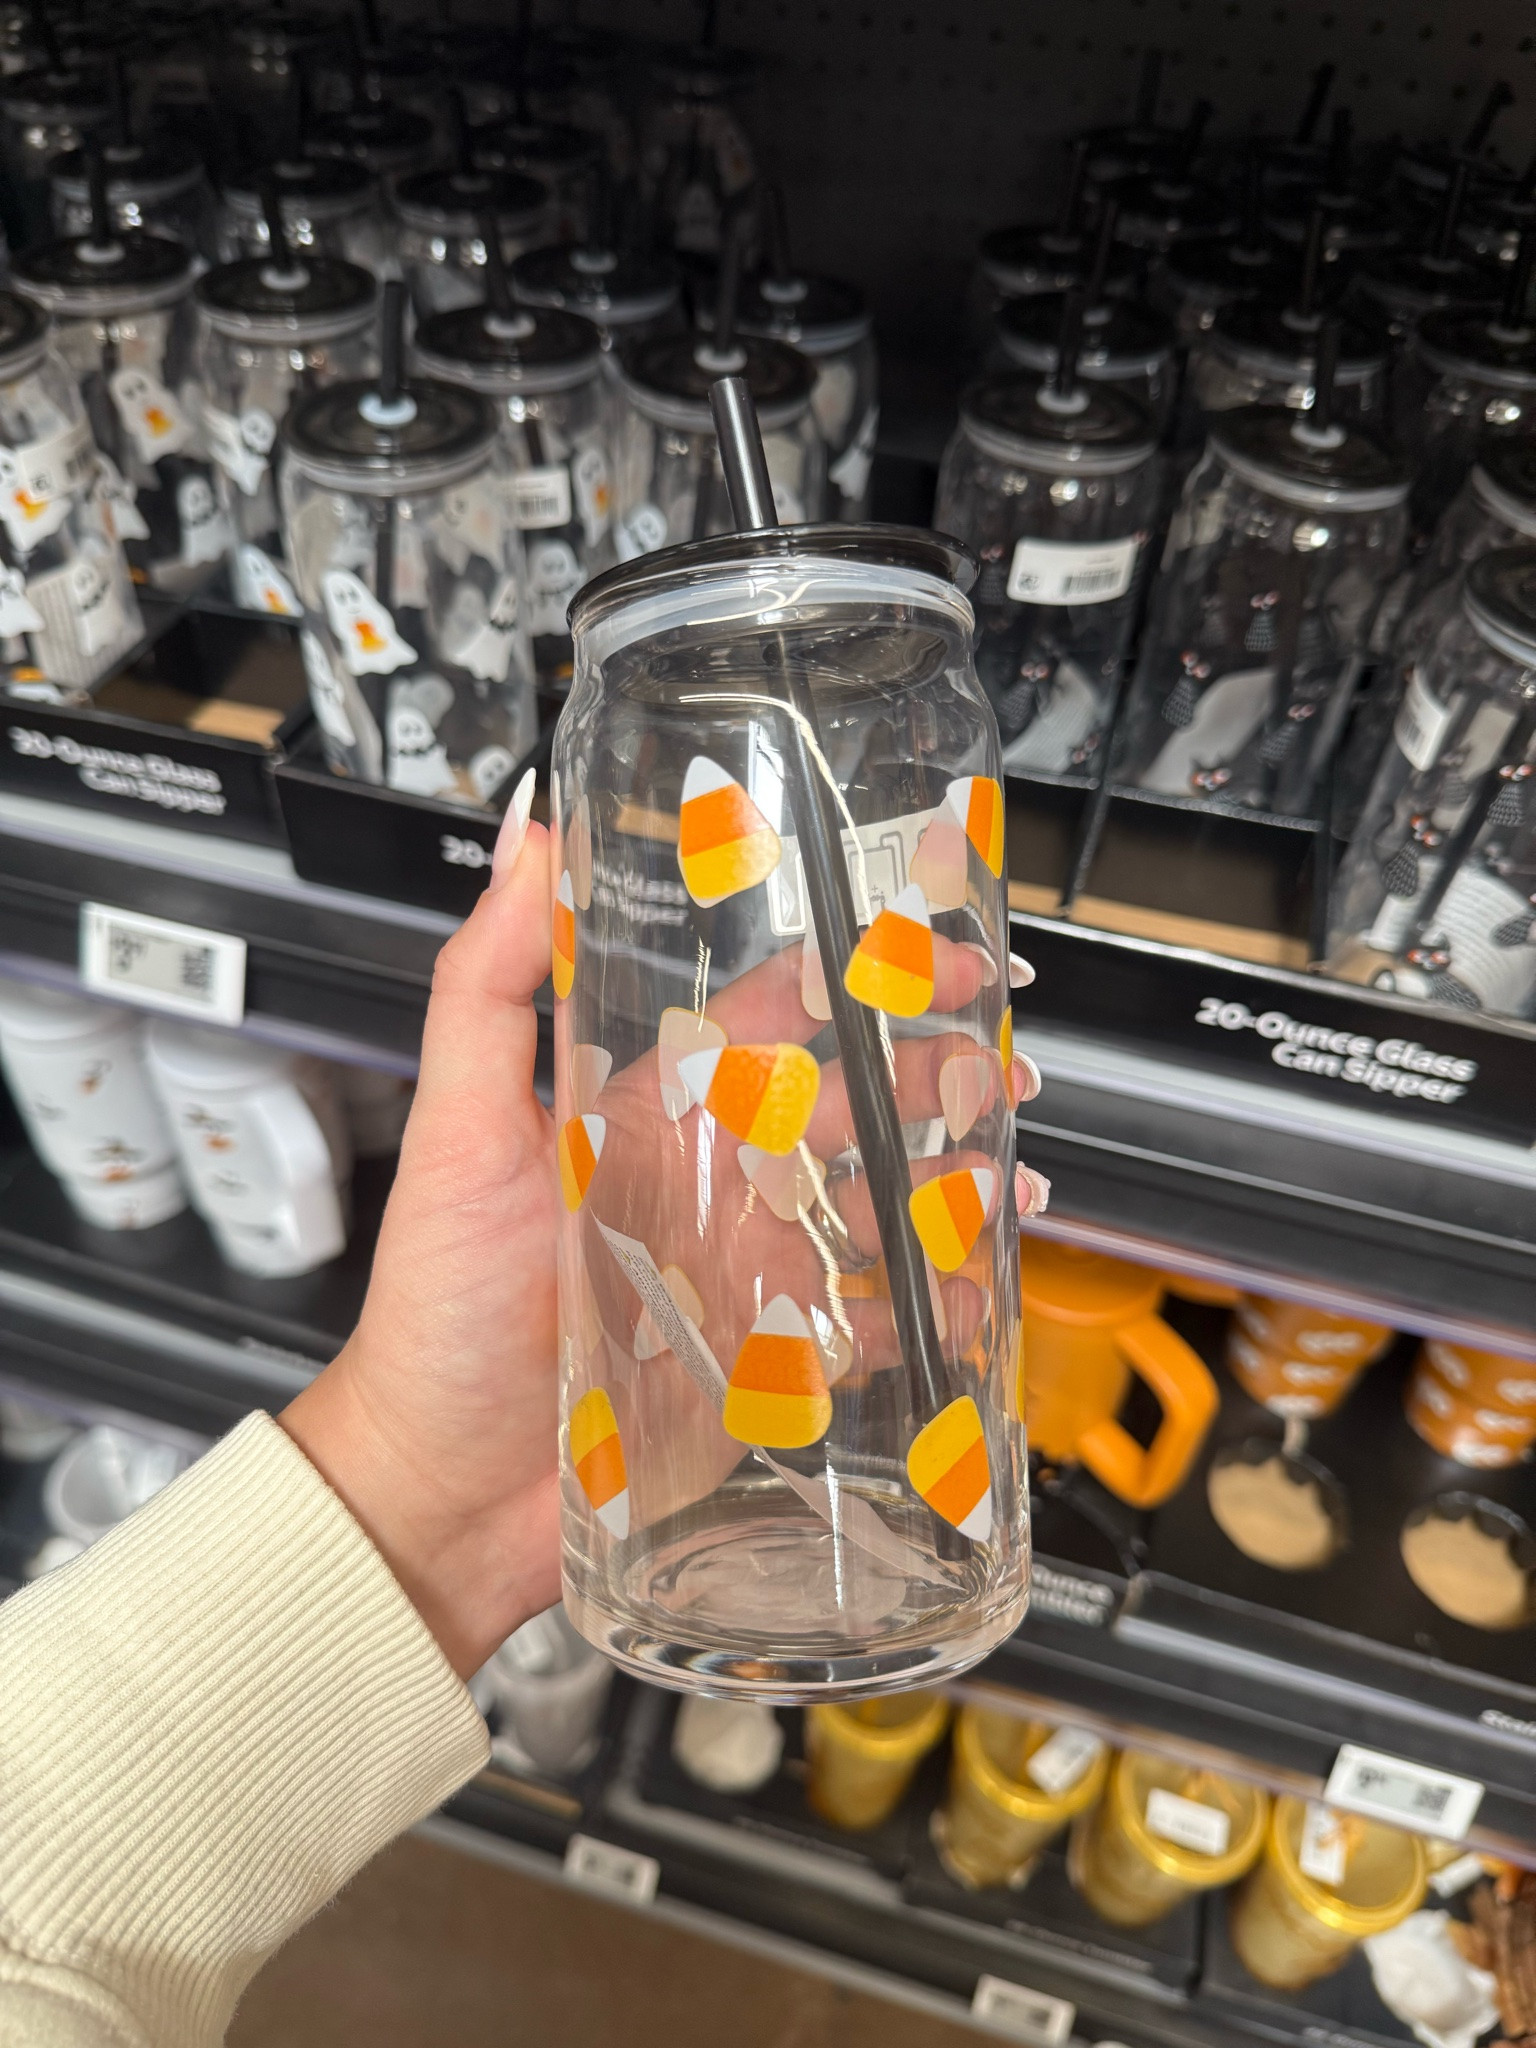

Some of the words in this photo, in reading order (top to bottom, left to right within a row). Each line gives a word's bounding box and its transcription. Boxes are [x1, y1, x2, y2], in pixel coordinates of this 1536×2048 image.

[79, 766, 138, 798] Can
[137, 778, 227, 816] Sipper
[141, 752, 223, 793] Glass
[1195, 997, 1378, 1059] 20-Ounce
[1375, 1038, 1480, 1083] Glass
[1271, 1041, 1344, 1078] Can
[1341, 1055, 1468, 1104] Sipper
